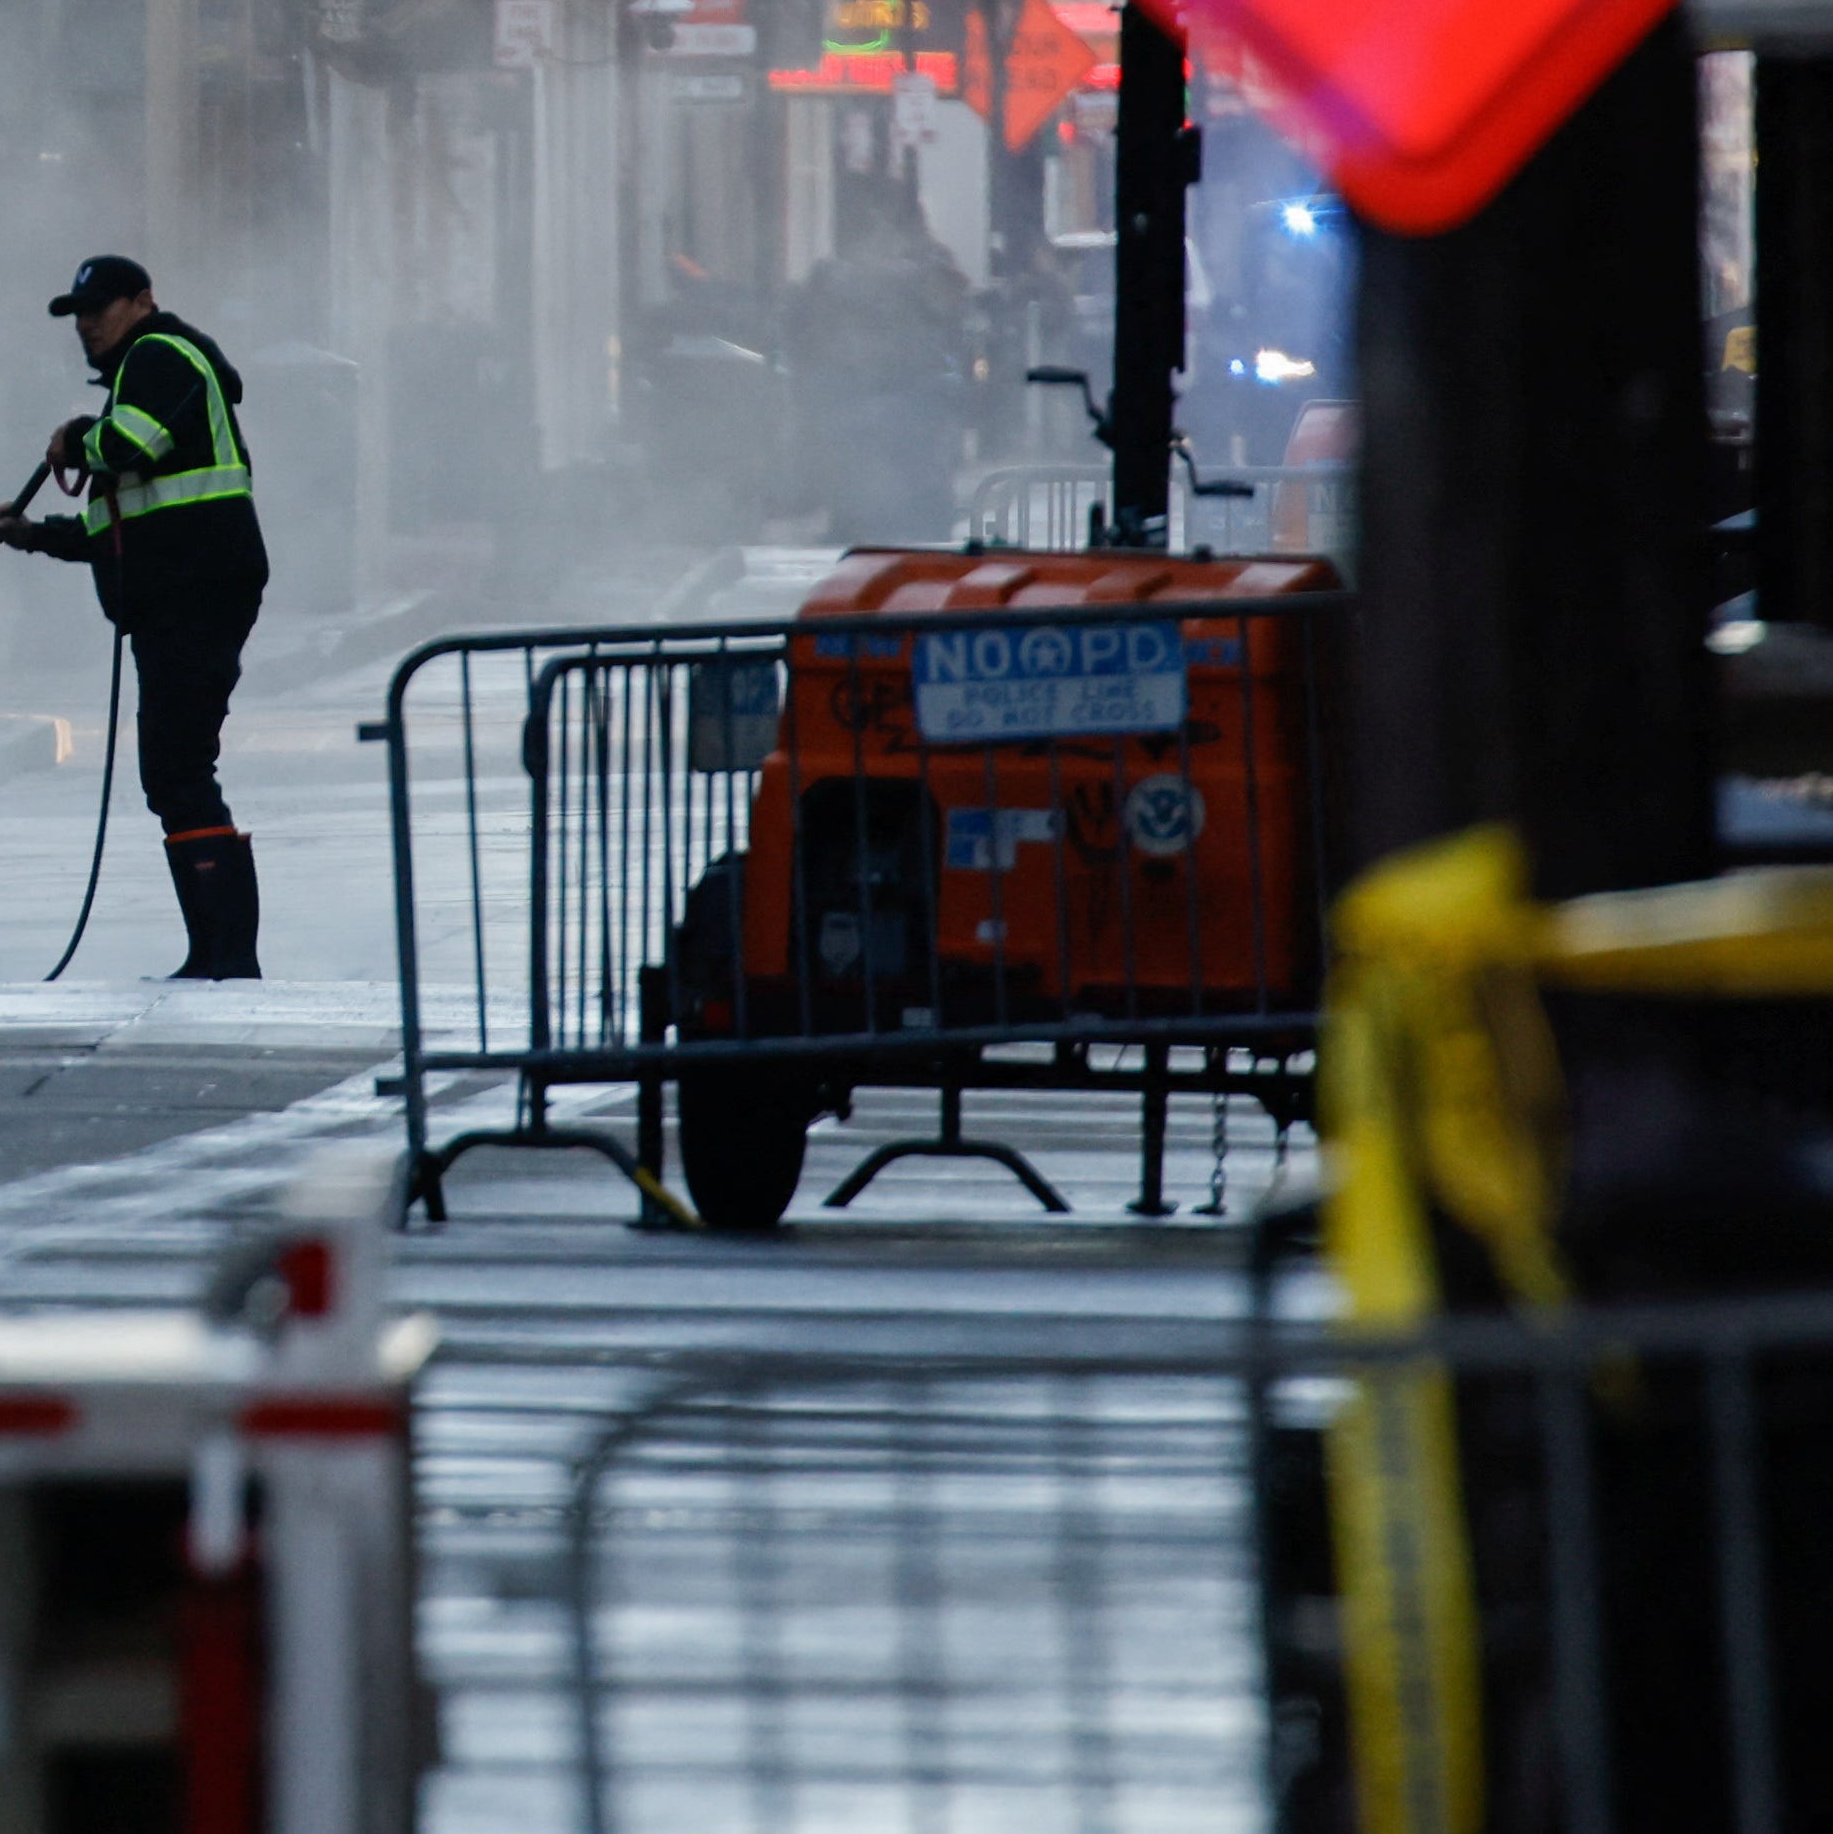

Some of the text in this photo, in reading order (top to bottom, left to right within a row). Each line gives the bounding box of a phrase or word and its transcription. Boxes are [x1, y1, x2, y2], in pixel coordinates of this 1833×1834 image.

[964, 677, 1143, 705] POLICE LINE
[946, 698, 1156, 729] DO NOT CROSS
